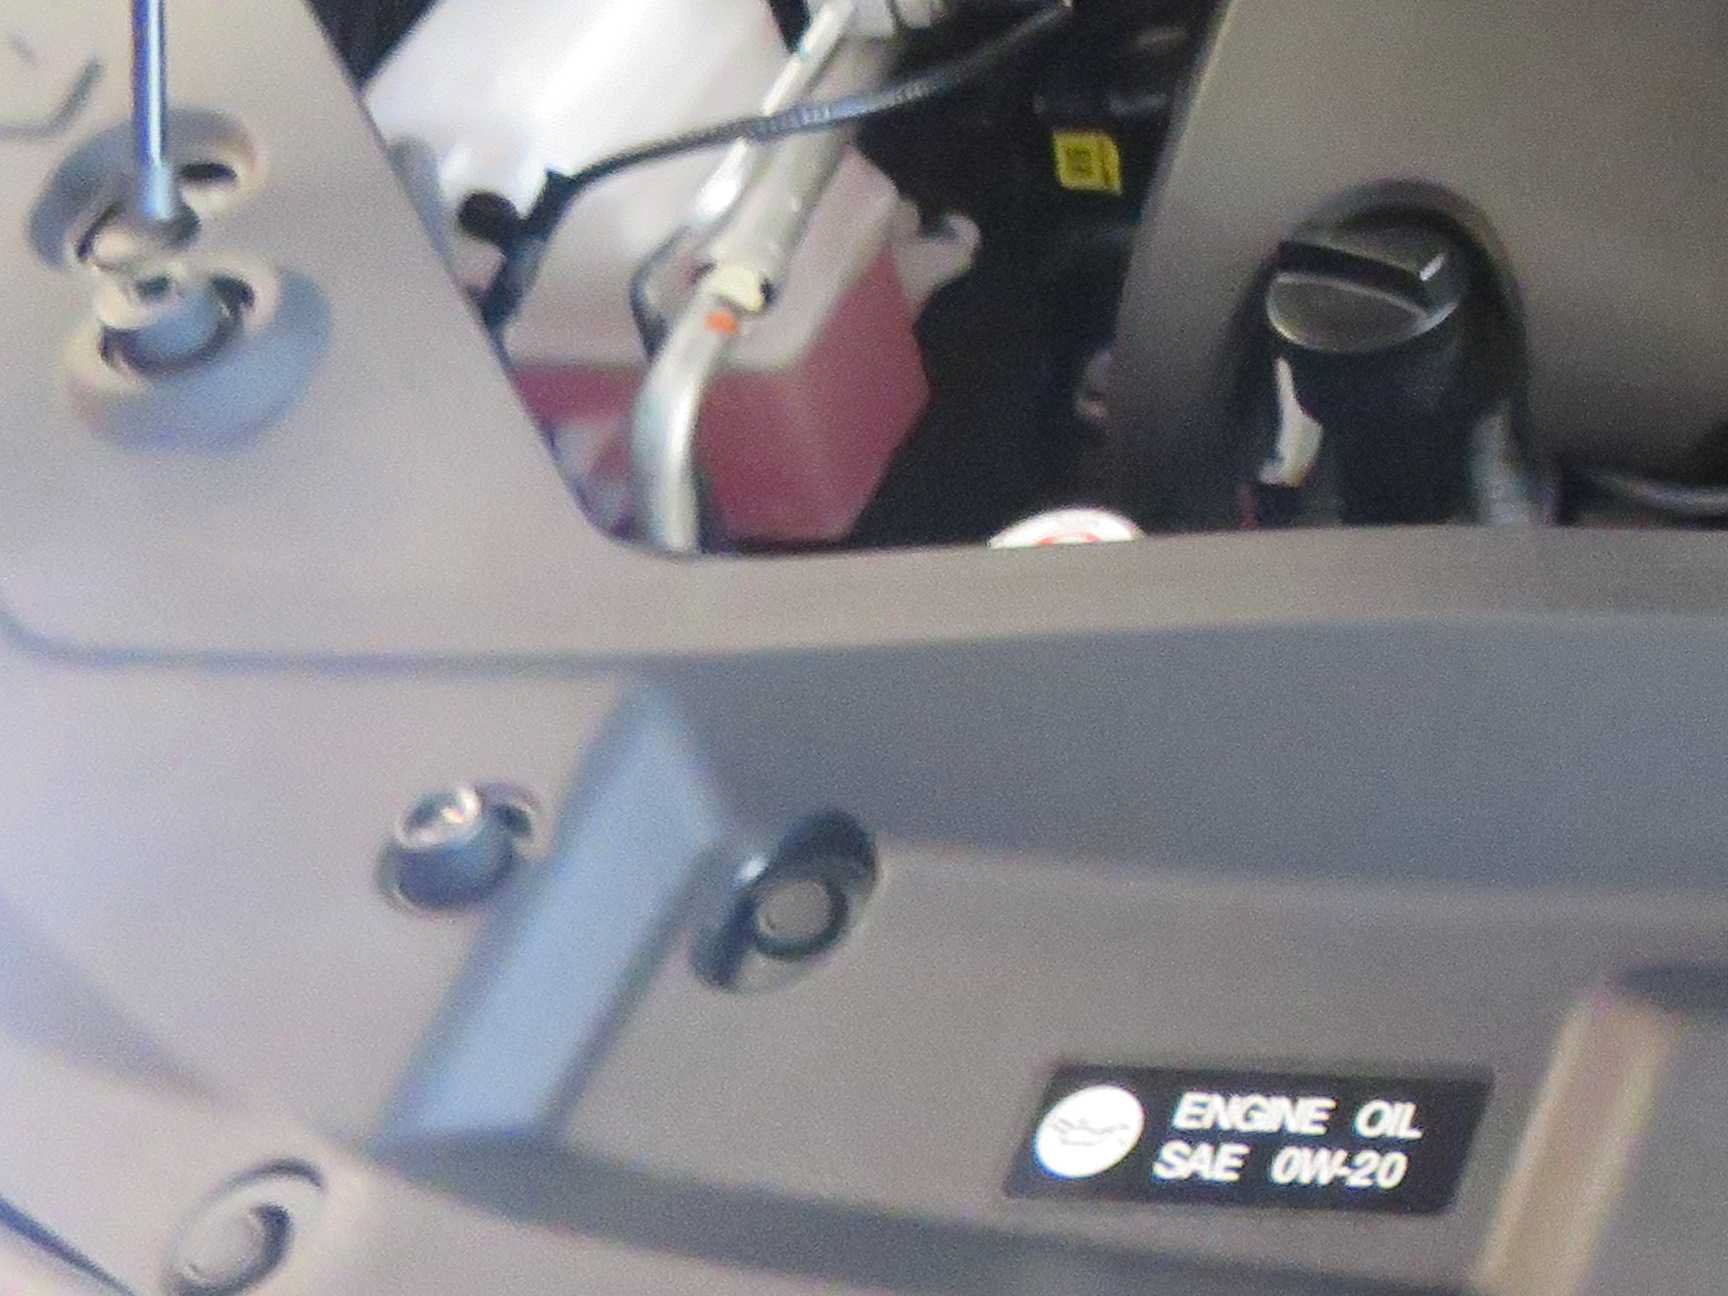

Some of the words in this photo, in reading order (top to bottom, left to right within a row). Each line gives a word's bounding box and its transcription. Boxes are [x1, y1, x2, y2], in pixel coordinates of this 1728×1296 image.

[1172, 1093, 1336, 1135] ENGINE
[1354, 1100, 1424, 1139] OIL
[1152, 1139, 1249, 1181] SAE
[1268, 1147, 1409, 1189] 0W-20
